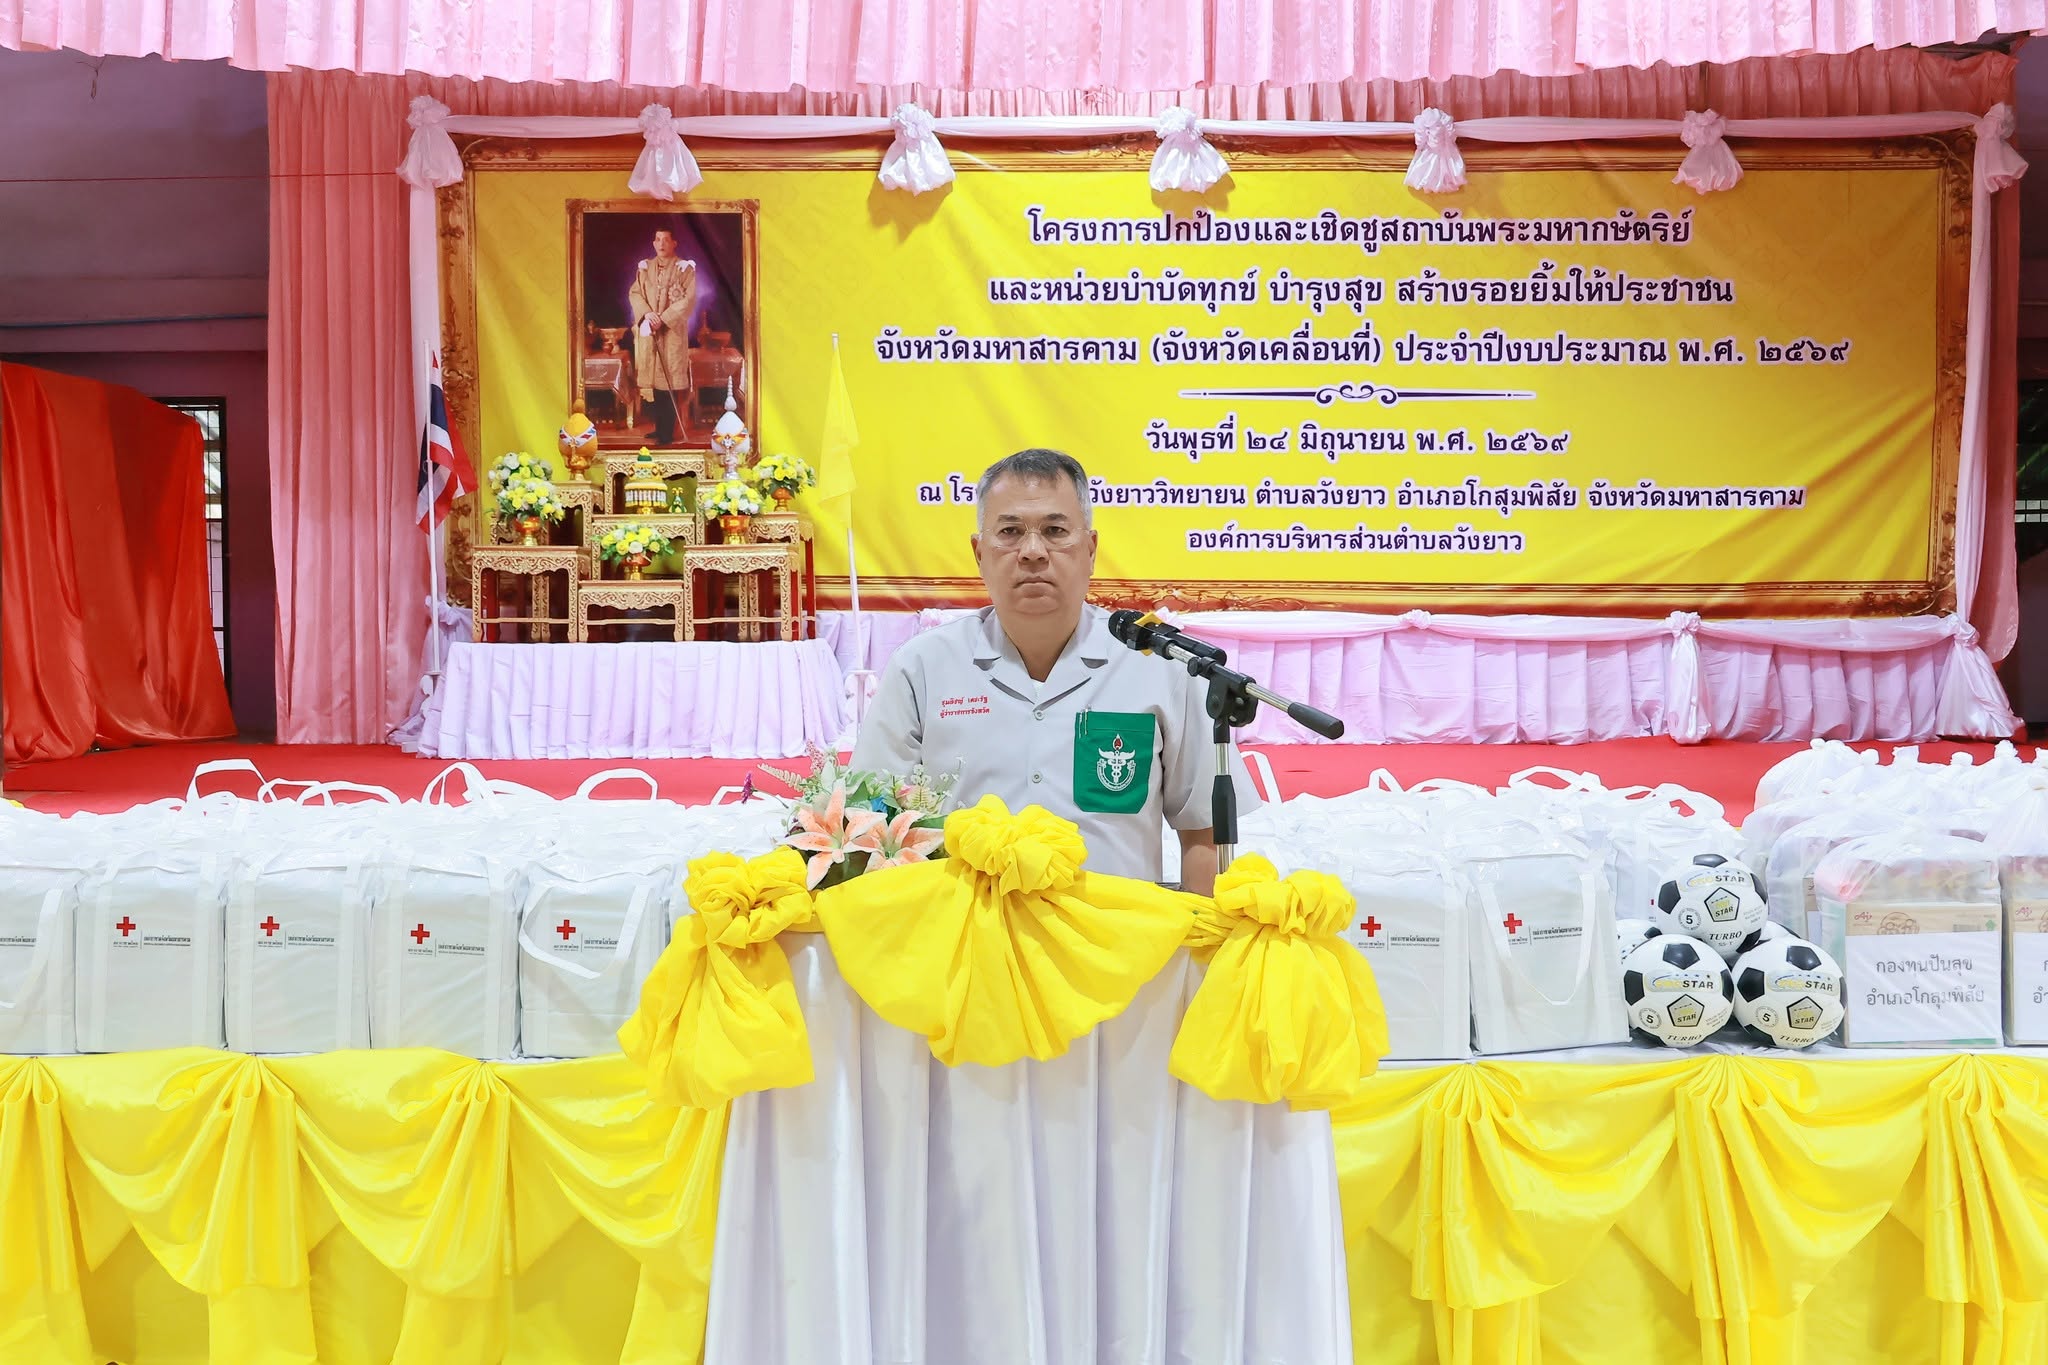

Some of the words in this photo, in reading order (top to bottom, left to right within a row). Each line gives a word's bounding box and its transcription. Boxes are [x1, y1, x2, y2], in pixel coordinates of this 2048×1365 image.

[1027, 208, 1692, 253] โครงการปกป้องและเชิดชูสถาบันพระมหากษัตริย์
[991, 269, 1257, 313] และหน่วยบำบัดทุกข์
[1269, 271, 1382, 313] บำรุงสุข
[1398, 262, 1733, 302] สร้างรอยยิ้มให้ประชาชน
[877, 329, 1136, 361] จังหวัดมหาสารคาม
[1153, 322, 1381, 363] (จังหวัดเคลื่อนที่)
[1395, 331, 1667, 362] ประจำปีงบประมาณ
[1678, 339, 1743, 362] พ.ศ.
[1759, 339, 1849, 362] ๒๕๖๙
[1146, 415, 1234, 460] วันพุธที่
[1247, 431, 1288, 450] ๒๔
[1301, 423, 1405, 460] มิถุนายน
[1416, 430, 1473, 451] พ.ศ.
[1487, 432, 1568, 451] ๒๕๖๙
[920, 486, 942, 502] ณ
[1256, 480, 1385, 505] ตำบลวังยาว
[1398, 479, 1576, 515] อำเภอโกสุมพิสัย
[1588, 481, 1804, 507] จังหวัดมหาสารคาม
[1189, 523, 1522, 550] องค์การบริหารส่วนตำบลวังยาว
[1686, 914, 1693, 925] 5
[1709, 931, 1742, 941] TURBO
[1876, 954, 1973, 977] กองทุนปันสุข
[1866, 985, 1984, 1009] อำเภอโกสุมพิสัย
[1646, 1014, 1654, 1024] 5
[1763, 1013, 1772, 1023] 5
